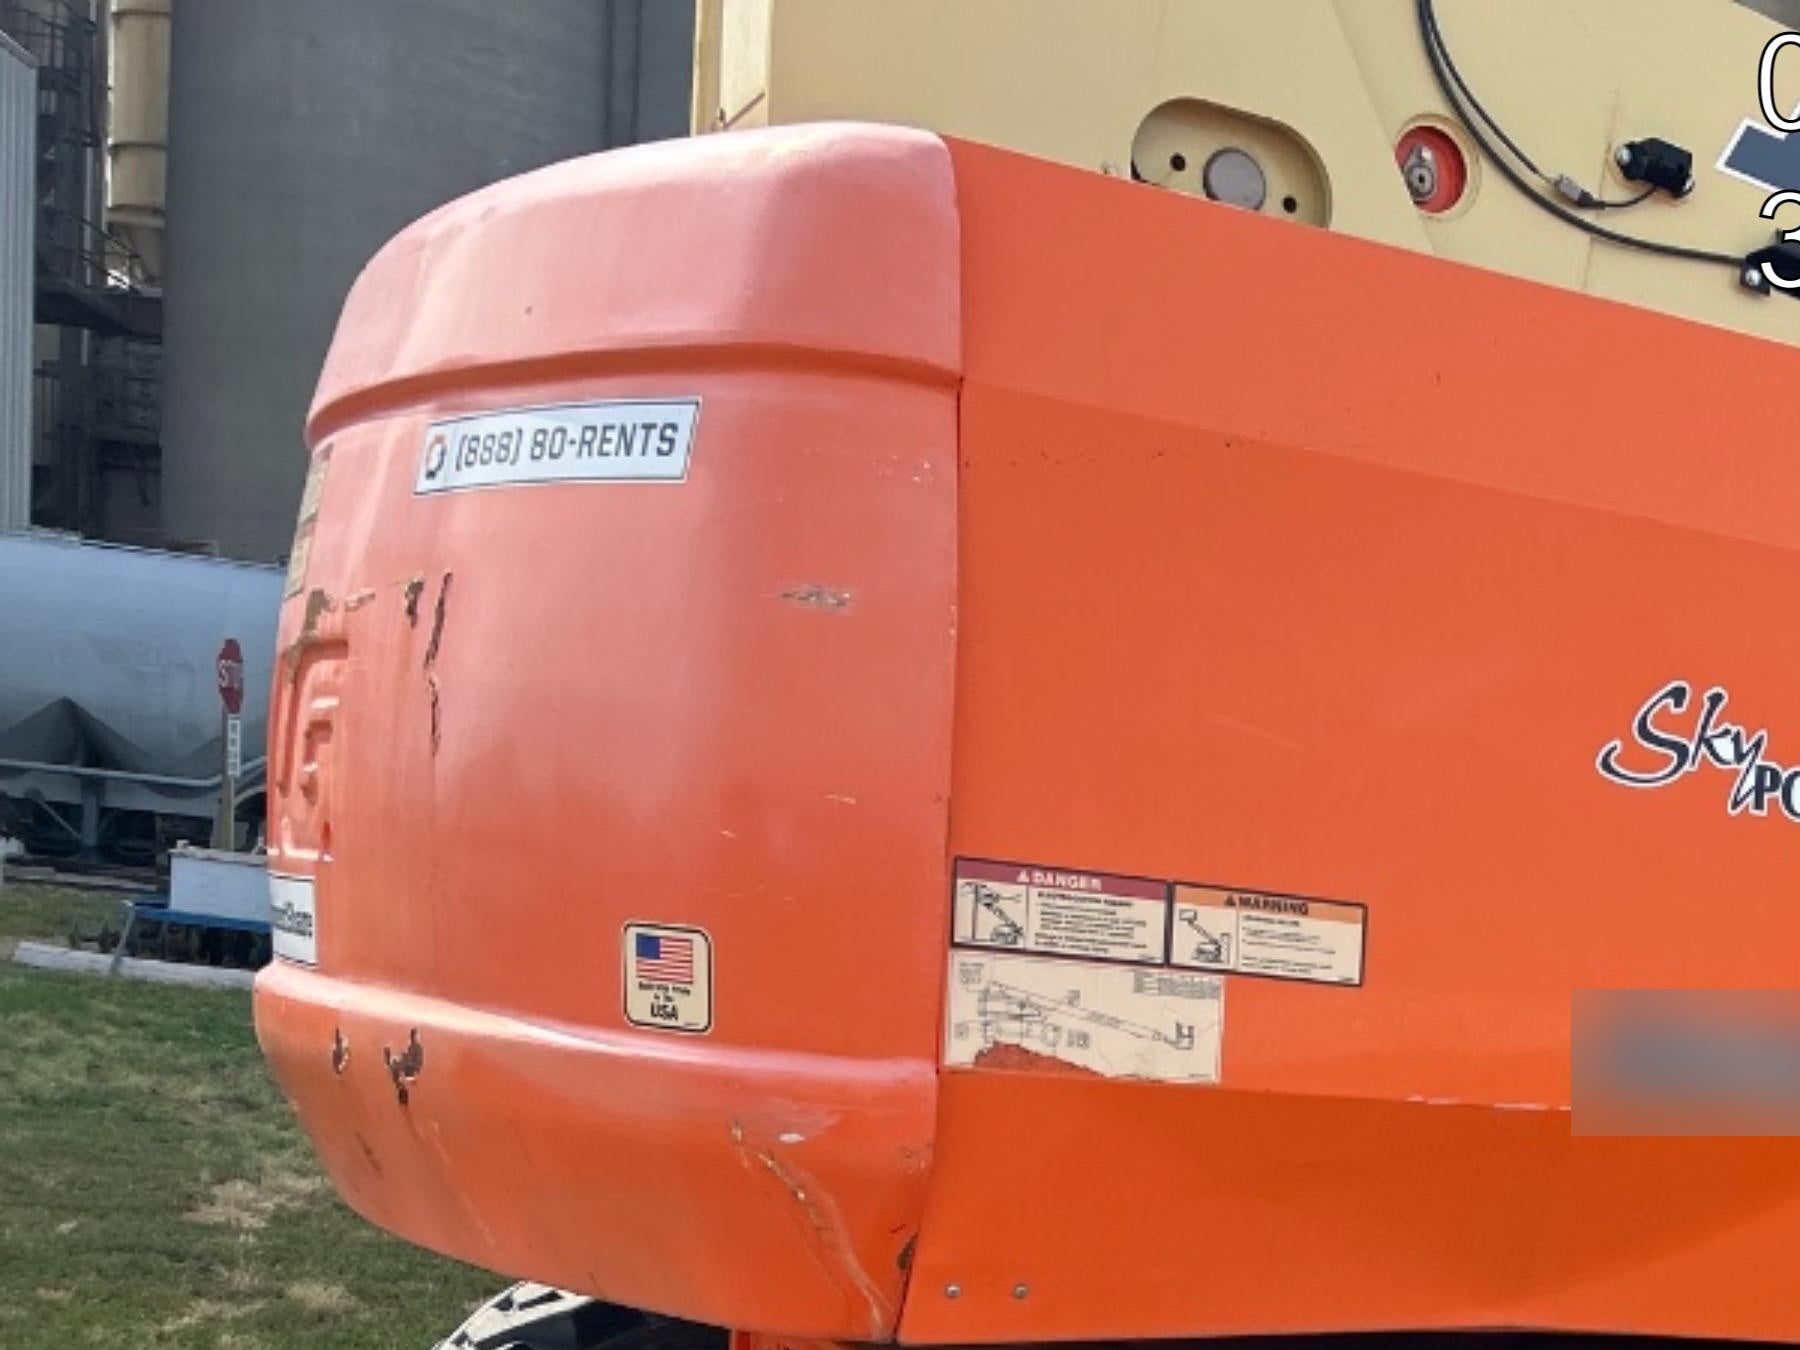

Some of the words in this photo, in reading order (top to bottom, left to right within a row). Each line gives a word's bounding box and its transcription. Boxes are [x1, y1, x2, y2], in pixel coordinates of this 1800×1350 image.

[455, 427, 523, 472] (888)
[530, 422, 679, 461] 80-RENTS
[1031, 871, 1102, 891] DANGER
[650, 1002, 678, 1021] USA
